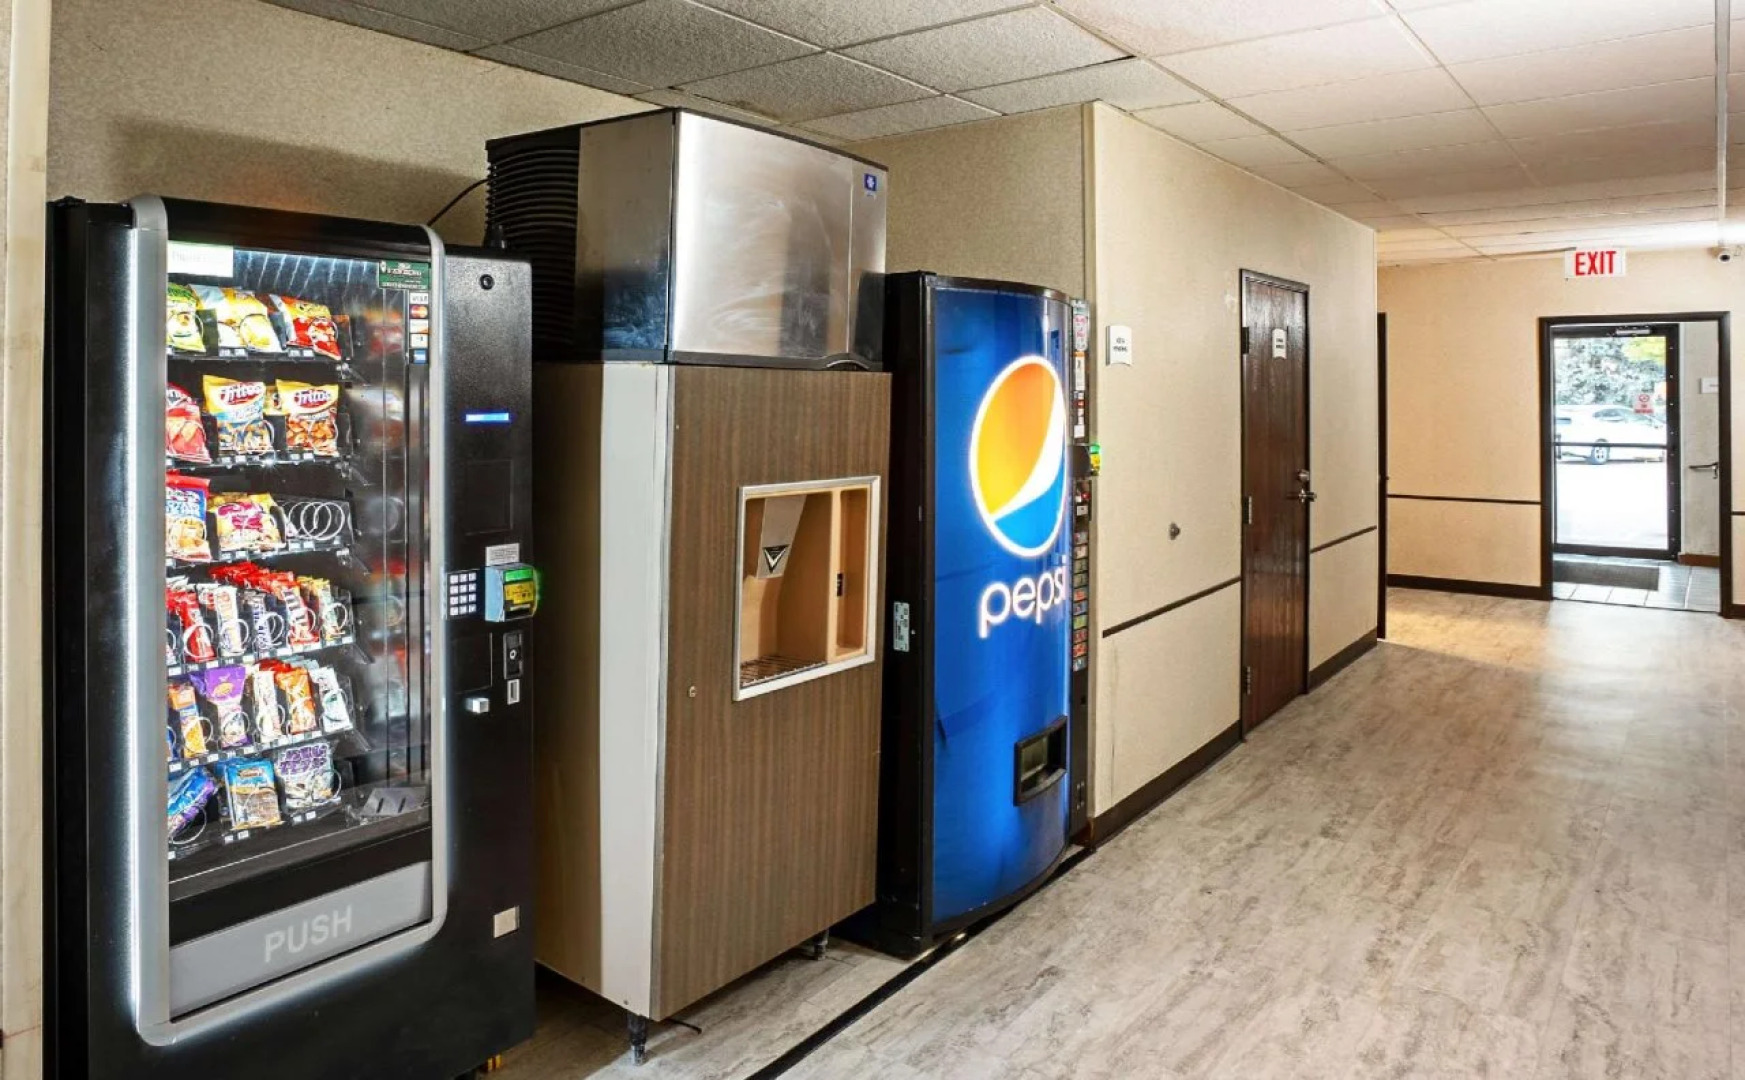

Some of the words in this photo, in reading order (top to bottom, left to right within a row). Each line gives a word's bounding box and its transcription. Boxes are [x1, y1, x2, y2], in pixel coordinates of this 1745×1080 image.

[1575, 251, 1617, 276] EXIT
[978, 554, 1067, 639] pepsi
[264, 904, 353, 963] PUSH
